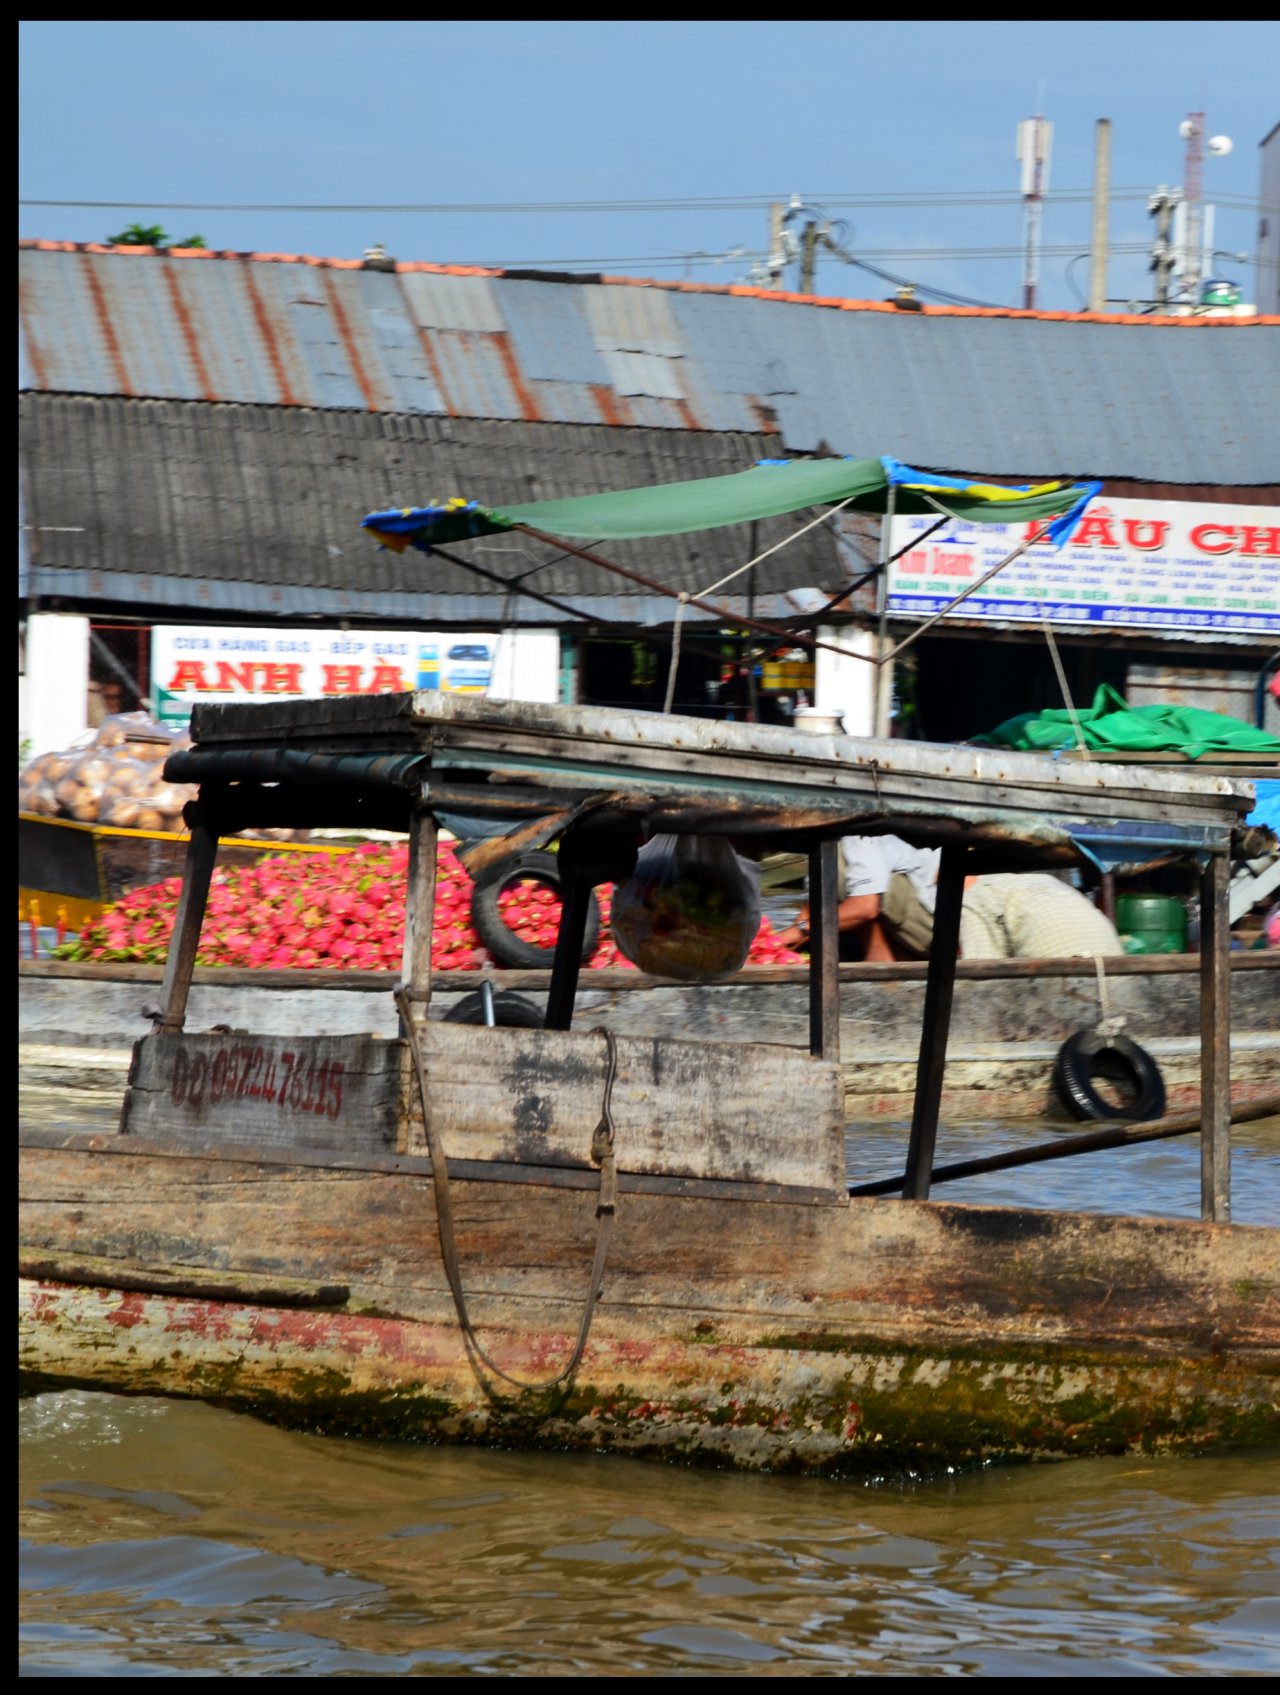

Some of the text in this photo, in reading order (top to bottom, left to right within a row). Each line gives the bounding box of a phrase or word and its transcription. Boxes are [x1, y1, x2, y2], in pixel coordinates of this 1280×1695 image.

[218, 635, 268, 652] HÀNG
[276, 640, 312, 653] GAS
[371, 642, 409, 656] GAS
[168, 656, 407, 695] ANH HÀ
